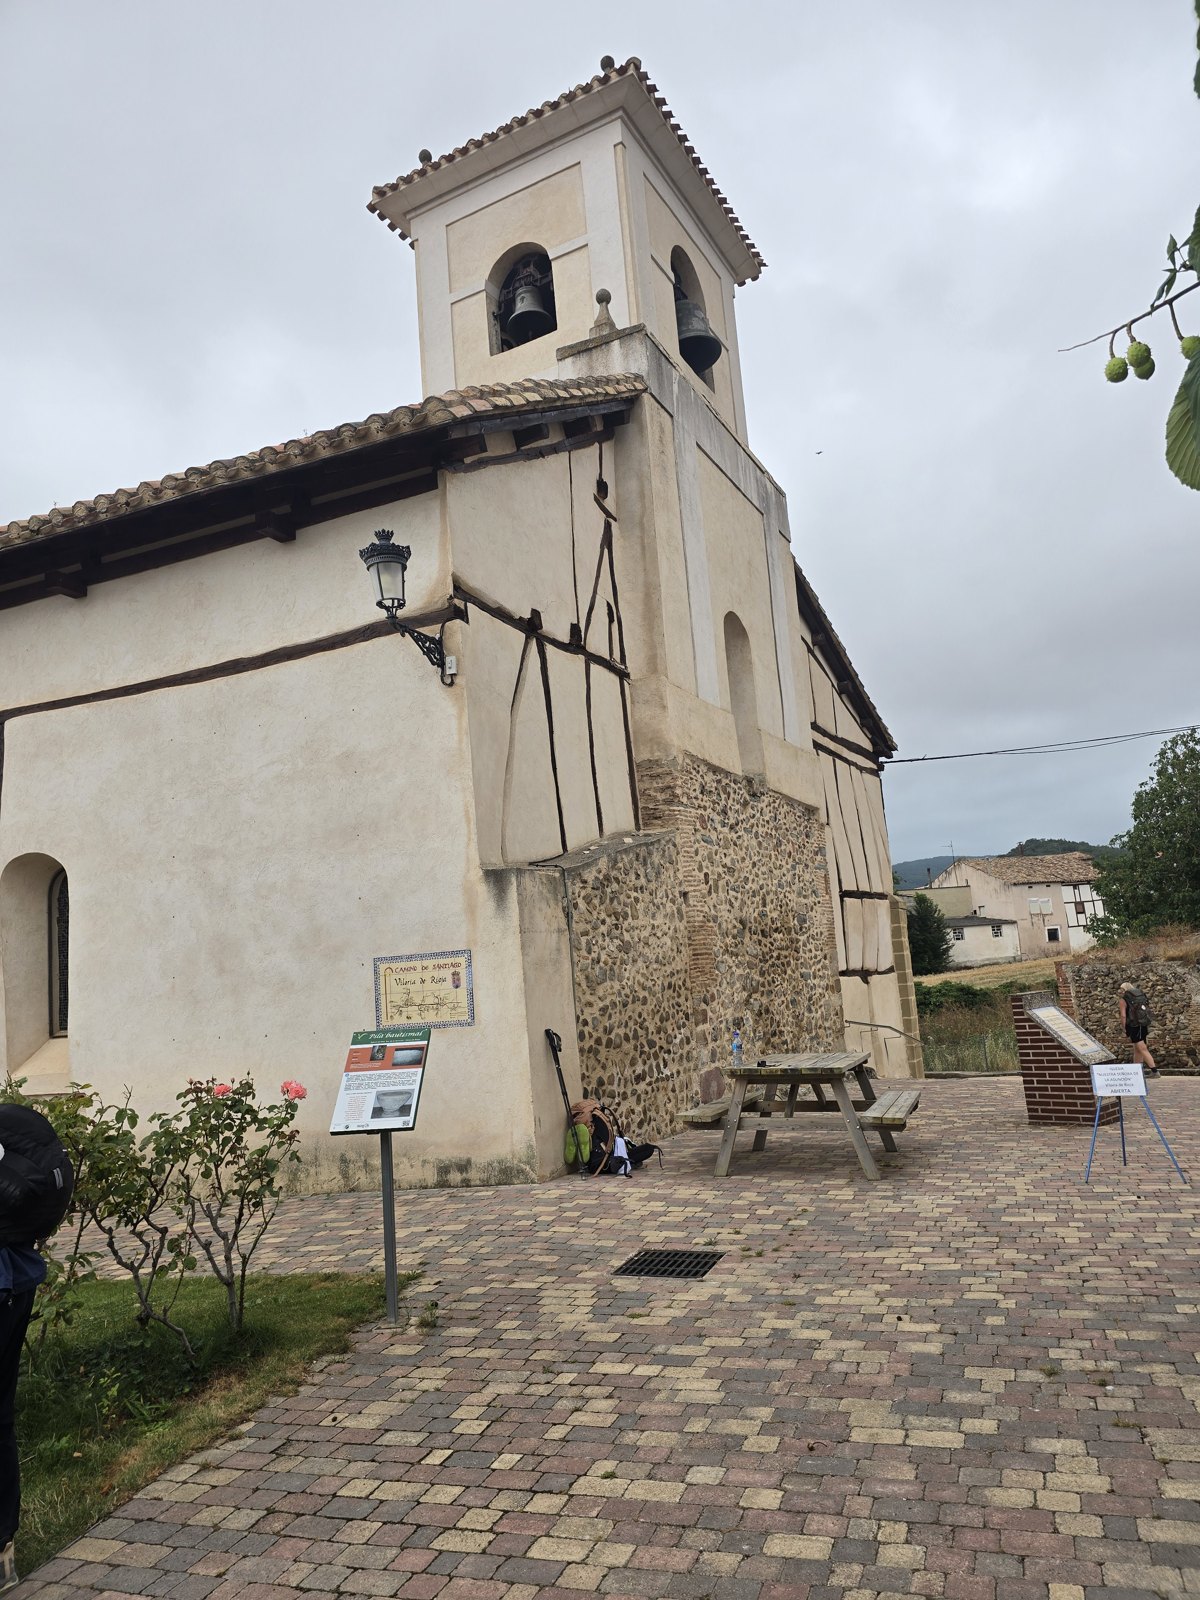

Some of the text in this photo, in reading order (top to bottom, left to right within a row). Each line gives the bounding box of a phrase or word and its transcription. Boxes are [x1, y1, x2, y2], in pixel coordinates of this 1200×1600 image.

[394, 965, 418, 973] CAMINO
[432, 962, 462, 970] SANTIAGO
[430, 976, 447, 986] Rioja
